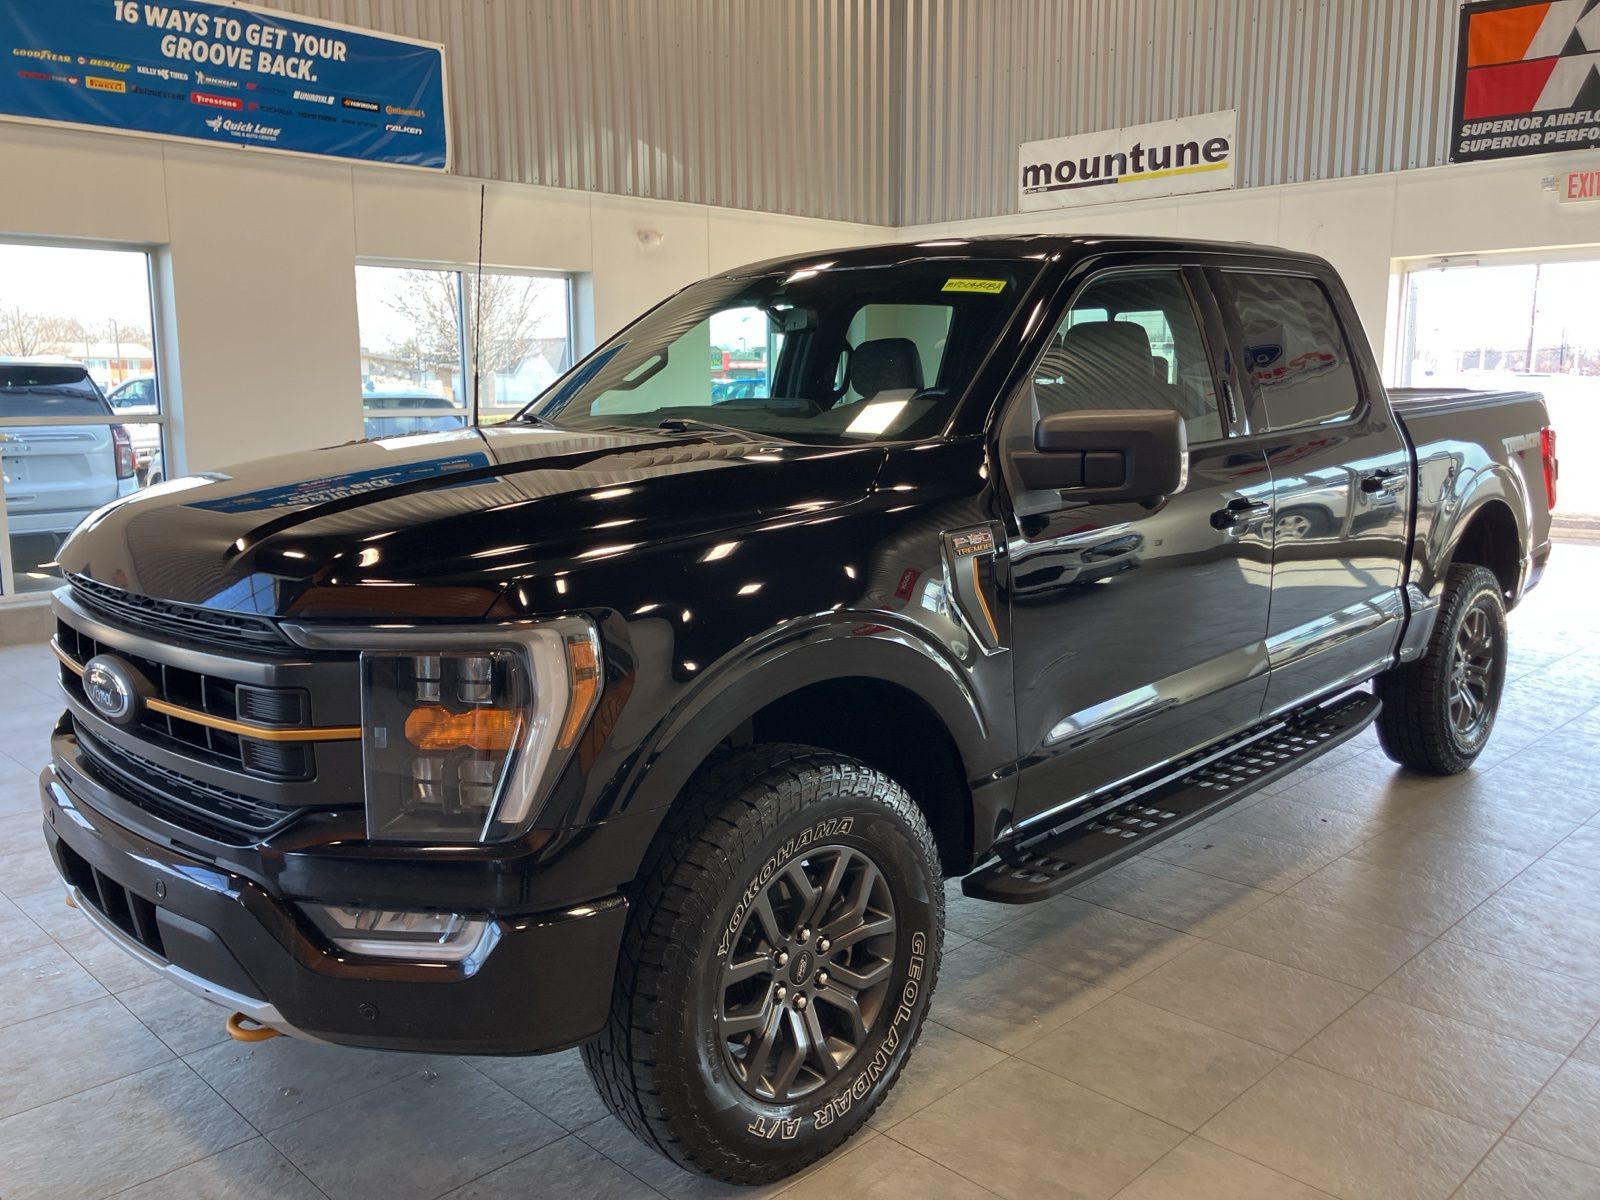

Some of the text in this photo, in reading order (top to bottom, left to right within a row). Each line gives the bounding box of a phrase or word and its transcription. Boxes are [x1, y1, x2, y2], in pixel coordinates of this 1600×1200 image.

[113, 0, 347, 62] 16 WAYS TO GET YOUR
[12, 48, 72, 63] GOODYEAR
[89, 58, 131, 71] DUNLOP
[161, 34, 318, 82] GROOVE BACK.
[223, 119, 281, 136] Quick Lane
[1460, 115, 1543, 137] SUPERIOR
[1459, 127, 1600, 153] SUPERIOR PERFO
[1022, 137, 1230, 188] mountune
[1568, 171, 1600, 199] EXIT
[956, 543, 993, 556] TREMOR
[716, 816, 854, 957] YOKOHAMA
[813, 931, 927, 1131] GEOLANDAR
[748, 1115, 803, 1140] A/T
